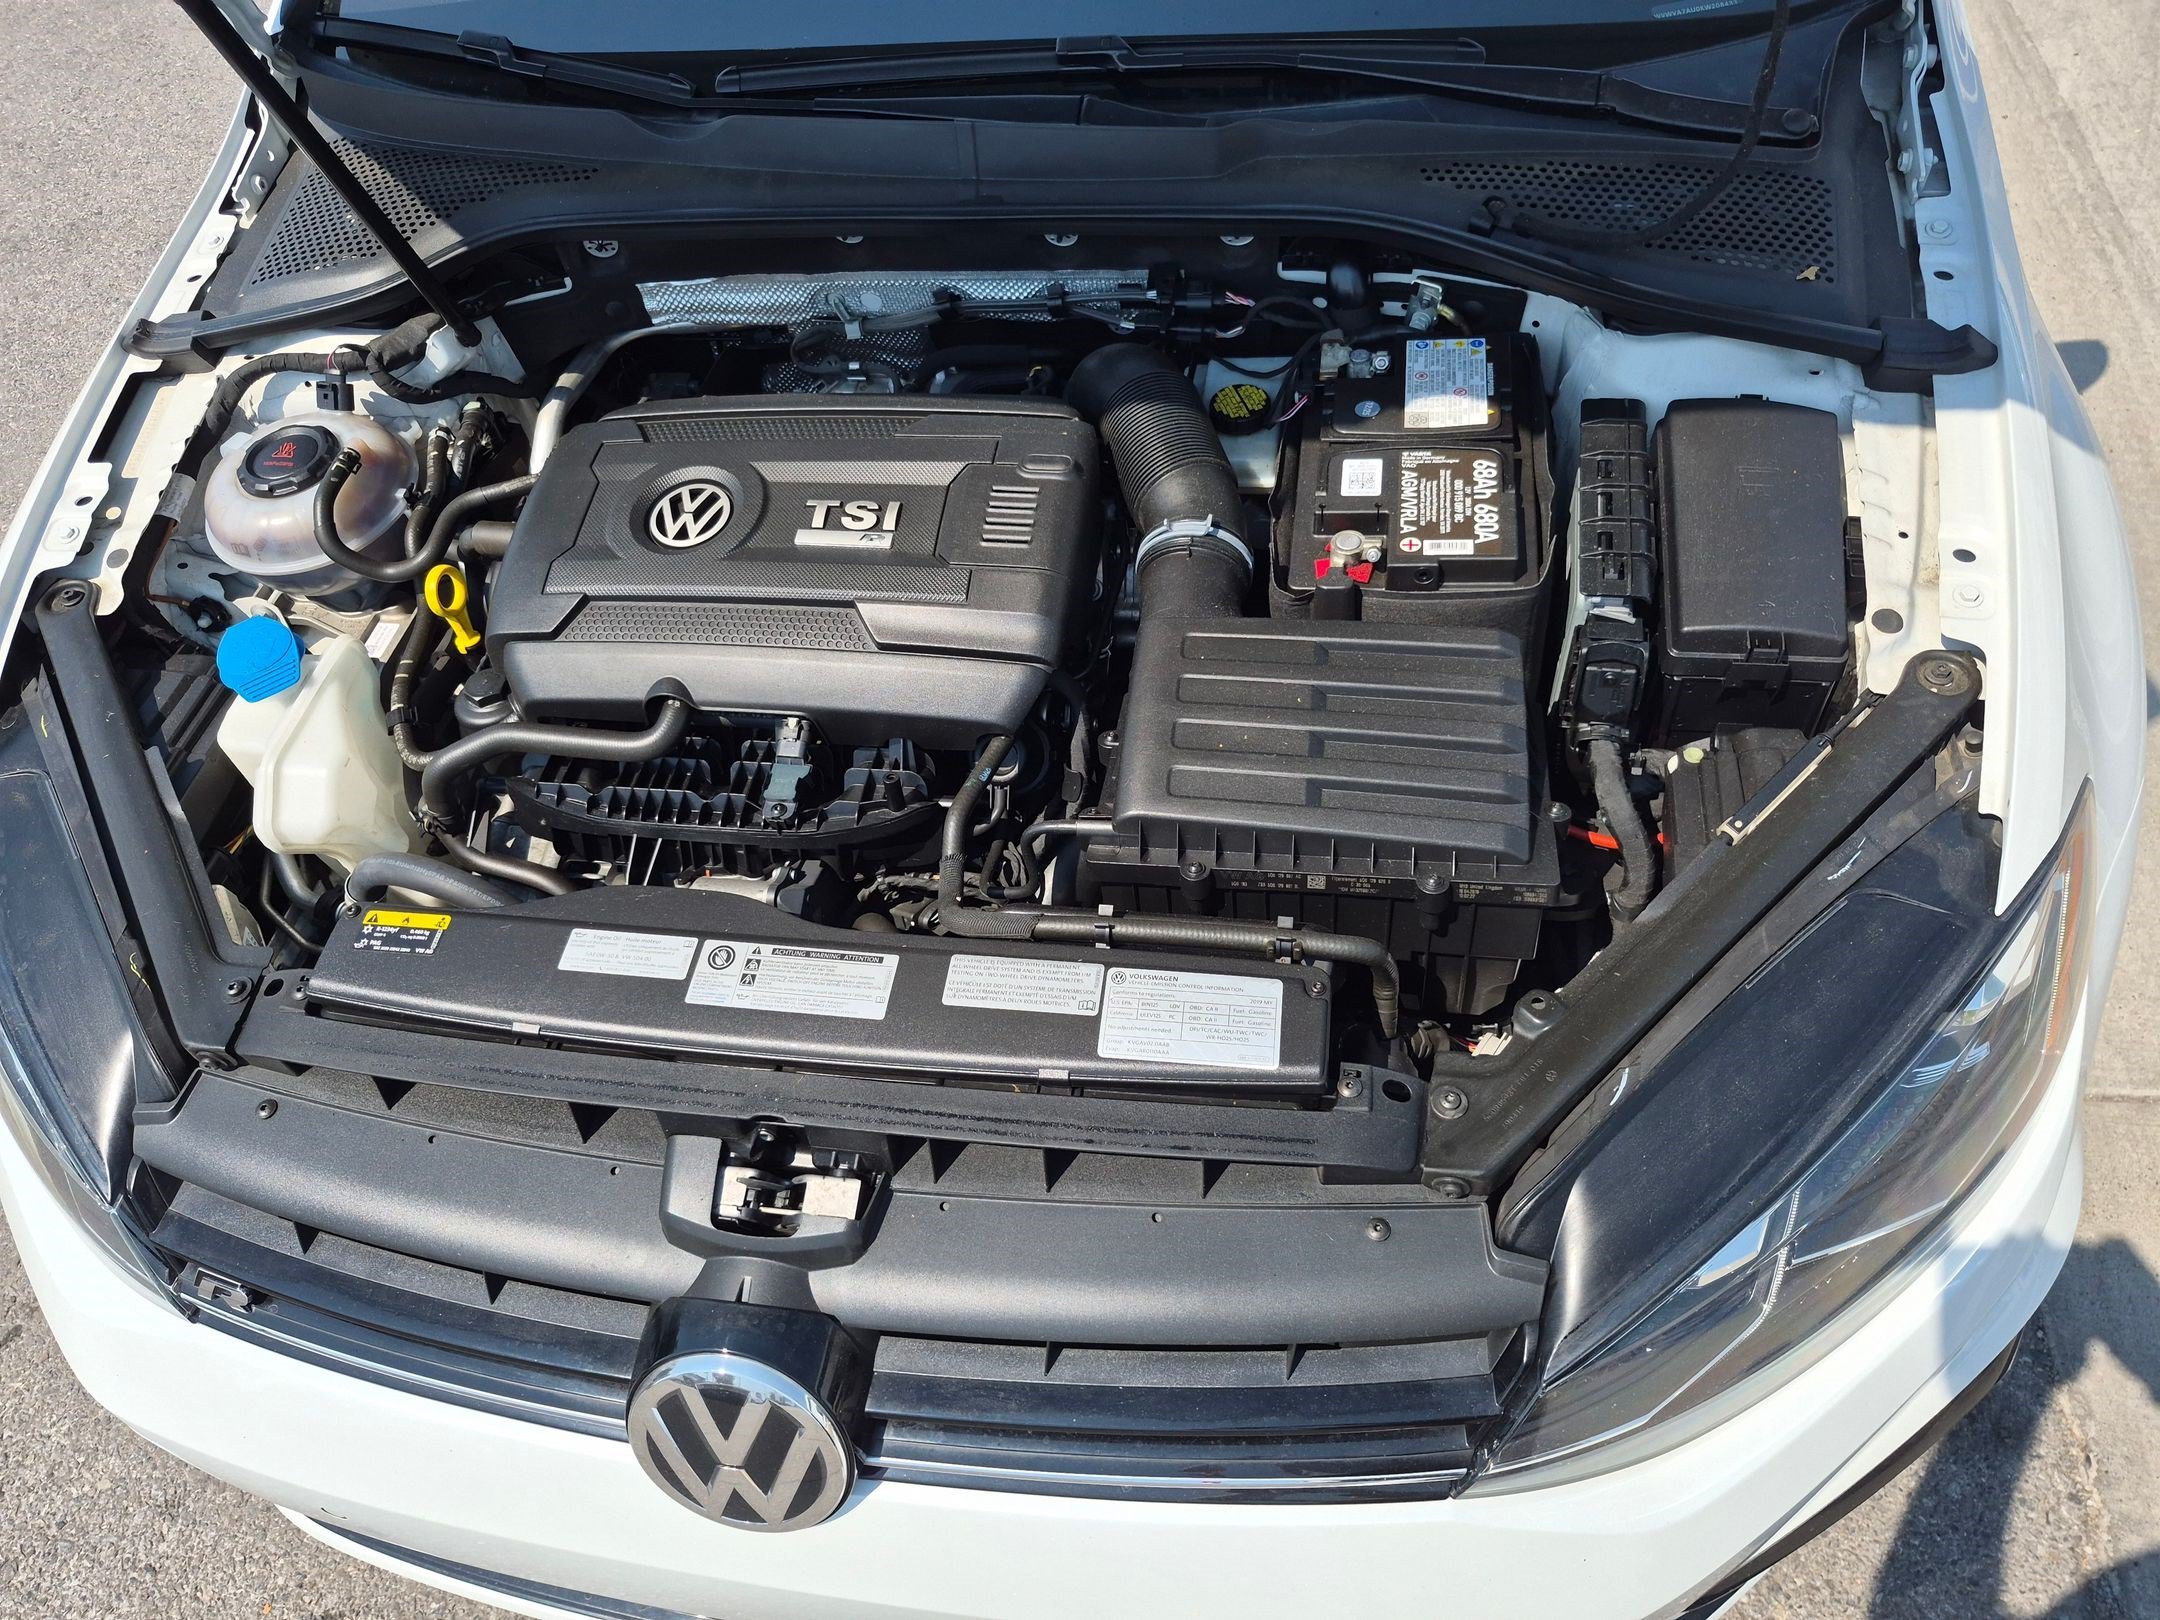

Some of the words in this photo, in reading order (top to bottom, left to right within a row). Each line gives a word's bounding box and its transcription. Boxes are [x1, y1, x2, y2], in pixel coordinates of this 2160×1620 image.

[1472, 459, 1498, 500] 68Ah
[805, 499, 901, 532] TSI
[1400, 470, 1419, 534] AGM/VRLA
[1454, 513, 1464, 523] BC
[1473, 503, 1500, 544] 680A
[773, 949, 807, 957] ACHTUNG
[809, 951, 841, 960] WARNING
[844, 954, 880, 963] ATTENTION
[1001, 966, 1022, 974] SYSTEM
[1128, 973, 1179, 982] VOLKSWAGEN
[627, 1352, 852, 1531] VW
